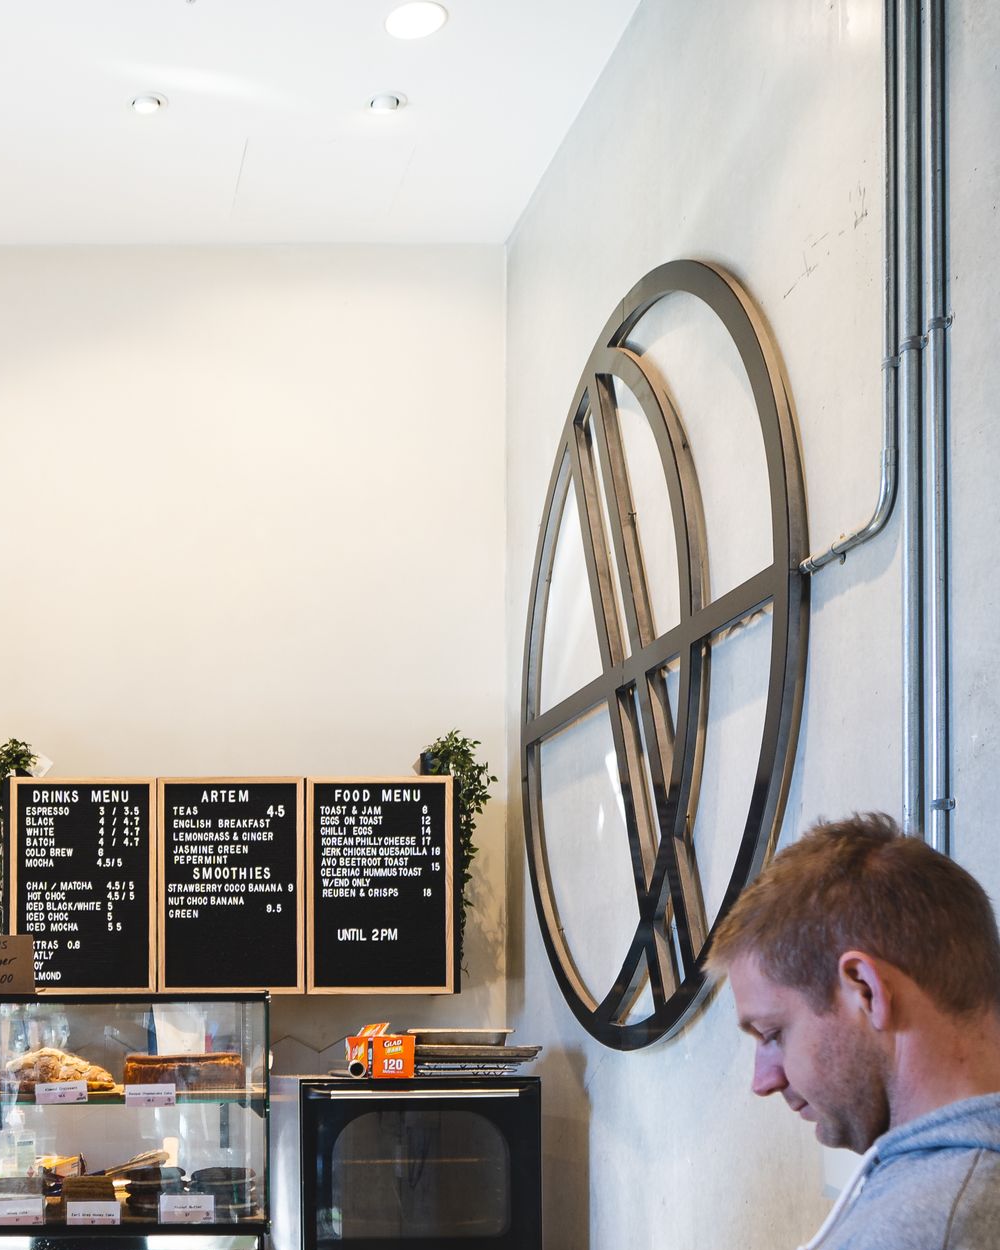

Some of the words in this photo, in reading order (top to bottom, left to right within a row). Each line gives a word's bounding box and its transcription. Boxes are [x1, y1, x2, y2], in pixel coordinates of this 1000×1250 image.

[33, 790, 78, 803] DRINKS
[91, 790, 128, 802] MENU
[201, 790, 248, 802] ARTEM
[335, 790, 370, 802] FOOD
[382, 789, 420, 802] MENU
[26, 807, 69, 815] ESPRESSO
[124, 807, 139, 815] 3.5
[173, 806, 198, 815] TEAS
[267, 805, 285, 817] 4.5
[320, 806, 346, 815] TOAST
[362, 806, 381, 815] JAM
[26, 817, 54, 826] BLACK
[123, 817, 139, 825] 4.7
[174, 819, 211, 828] ENGLISH
[218, 819, 270, 828] BREAKFAST
[321, 816, 339, 825] EGGS
[344, 816, 355, 825] ON
[359, 816, 383, 825] TOAST
[422, 816, 431, 824] 12
[26, 827, 54, 836] WHITE
[124, 827, 140, 836] 4.7
[320, 827, 346, 835] CHILLI
[353, 826, 372, 835] EGGS
[422, 826, 431, 835] 14
[173, 832, 230, 841] LEMONGRASS
[242, 832, 273, 841] GINGER
[26, 838, 55, 846] BATCH
[123, 837, 139, 846] 4.7
[322, 837, 354, 846] KOREAN
[356, 837, 382, 845] PHILLY
[384, 837, 416, 845] CHEESE
[422, 837, 431, 845] 17
[26, 848, 46, 857] COLD
[50, 848, 73, 857] BREW
[173, 845, 213, 854] JASMINE
[218, 845, 248, 854] GREEN
[322, 847, 341, 856] JERK
[343, 847, 377, 856] CHICKEN
[379, 847, 427, 856] QUESADILLA
[26, 858, 54, 867] MOCHA
[174, 855, 227, 864] PEPERMINT
[321, 858, 337, 866] AVO
[340, 858, 381, 866] BEETROOT
[384, 858, 408, 866] TOAST
[432, 862, 440, 871] 15
[193, 867, 270, 879] SMOOTHIES
[321, 868, 360, 877] CELERIAC
[364, 868, 397, 876] HUMMUS
[399, 868, 422, 876] TOAST
[26, 882, 47, 890] CHAI
[61, 881, 92, 890] MATCHA
[107, 881, 120, 890] 4.5
[322, 878, 349, 887] W/END
[352, 878, 370, 887] ONLY
[168, 883, 222, 892] STRAWBERRY
[224, 884, 245, 892] COCO
[249, 883, 282, 892] BANANA
[28, 892, 41, 900] HOT
[45, 892, 65, 900] CHOC
[107, 892, 119, 900] 4.5
[323, 888, 355, 897] REUBEN
[359, 888, 365, 897] &
[368, 888, 398, 897] CRISPS
[169, 896, 184, 905] NUT
[187, 897, 207, 905] CHOC
[211, 896, 244, 905] BANANA
[26, 902, 44, 911] ICED
[47, 902, 101, 911] BLACK/WHITE
[27, 912, 44, 921] ICED
[48, 912, 68, 921] CHOC
[169, 909, 198, 918] GREEN
[27, 923, 45, 931] ICED
[51, 923, 78, 931] MOCHA
[338, 928, 366, 941] UNTIL
[33, 940, 58, 949] TRAS
[34, 951, 53, 960] ATLY
[34, 961, 43, 970] OY
[34, 971, 61, 980] LMOND
[384, 1040, 402, 1048] GLAD
[383, 1058, 403, 1070] 120
